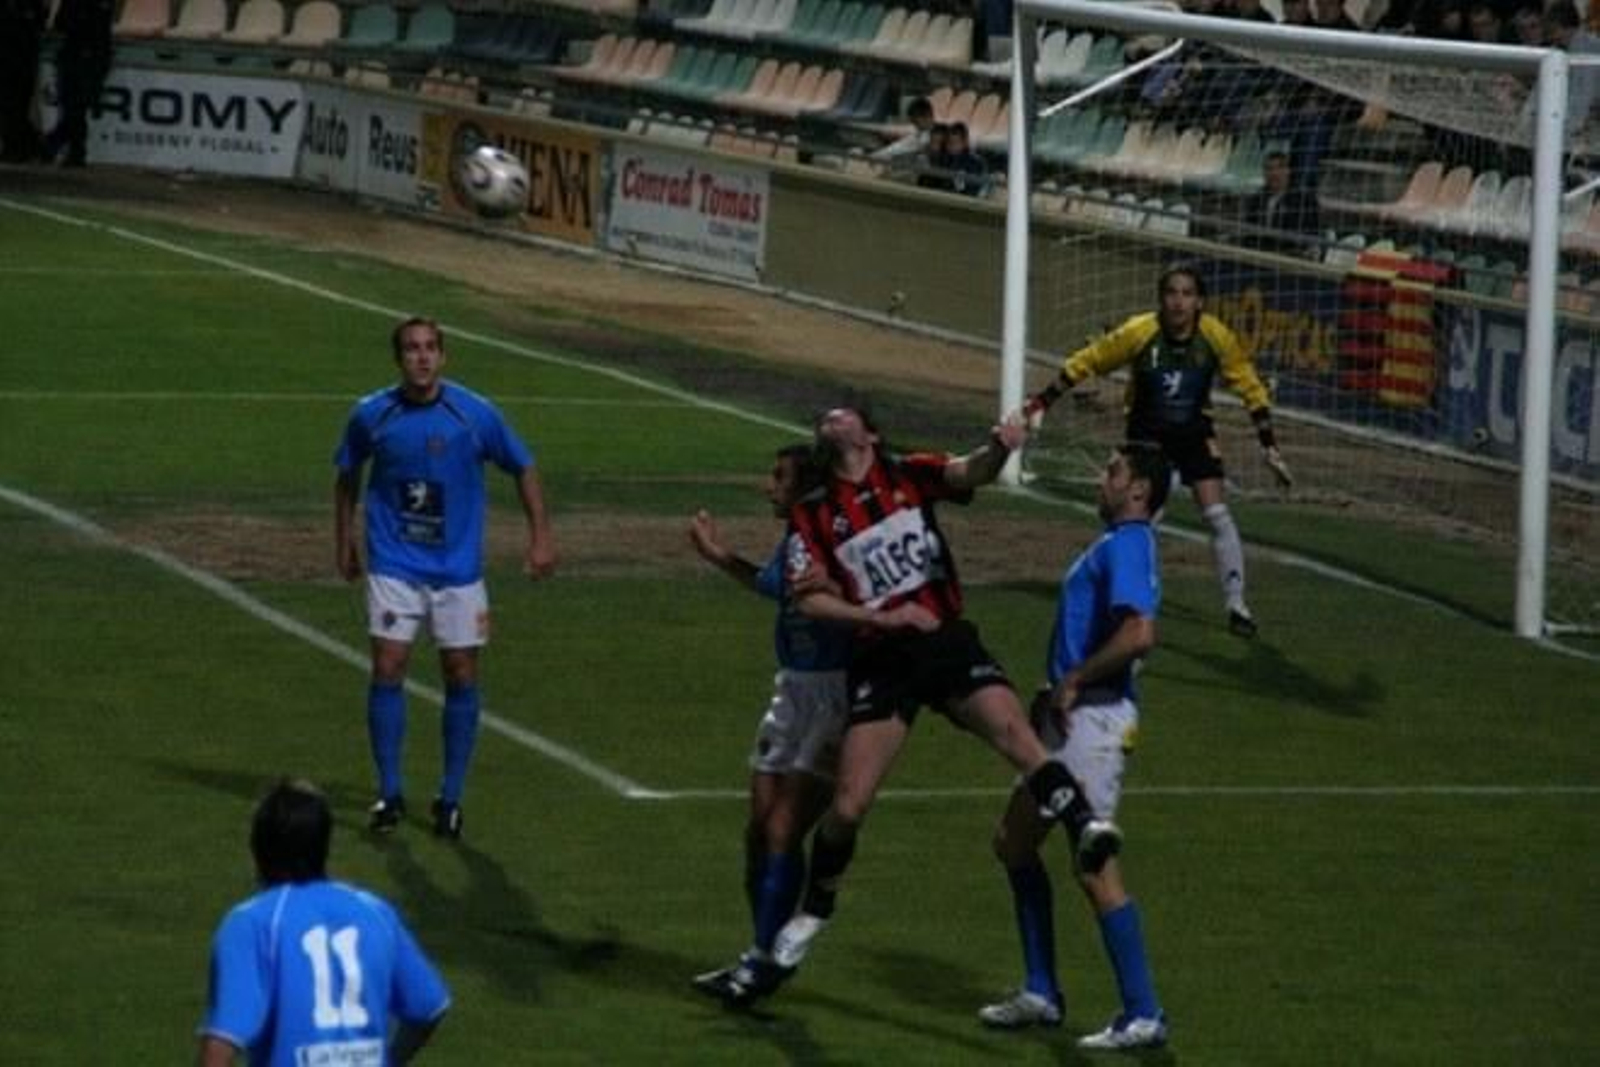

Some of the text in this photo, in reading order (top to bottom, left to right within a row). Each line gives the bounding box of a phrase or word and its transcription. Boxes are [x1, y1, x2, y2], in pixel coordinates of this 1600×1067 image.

[91, 85, 297, 134] ROMY
[302, 102, 419, 175] Auto Reus
[199, 136, 264, 156] FLORAL
[621, 156, 762, 224] Conrad Tomas
[302, 924, 370, 1029] 11
